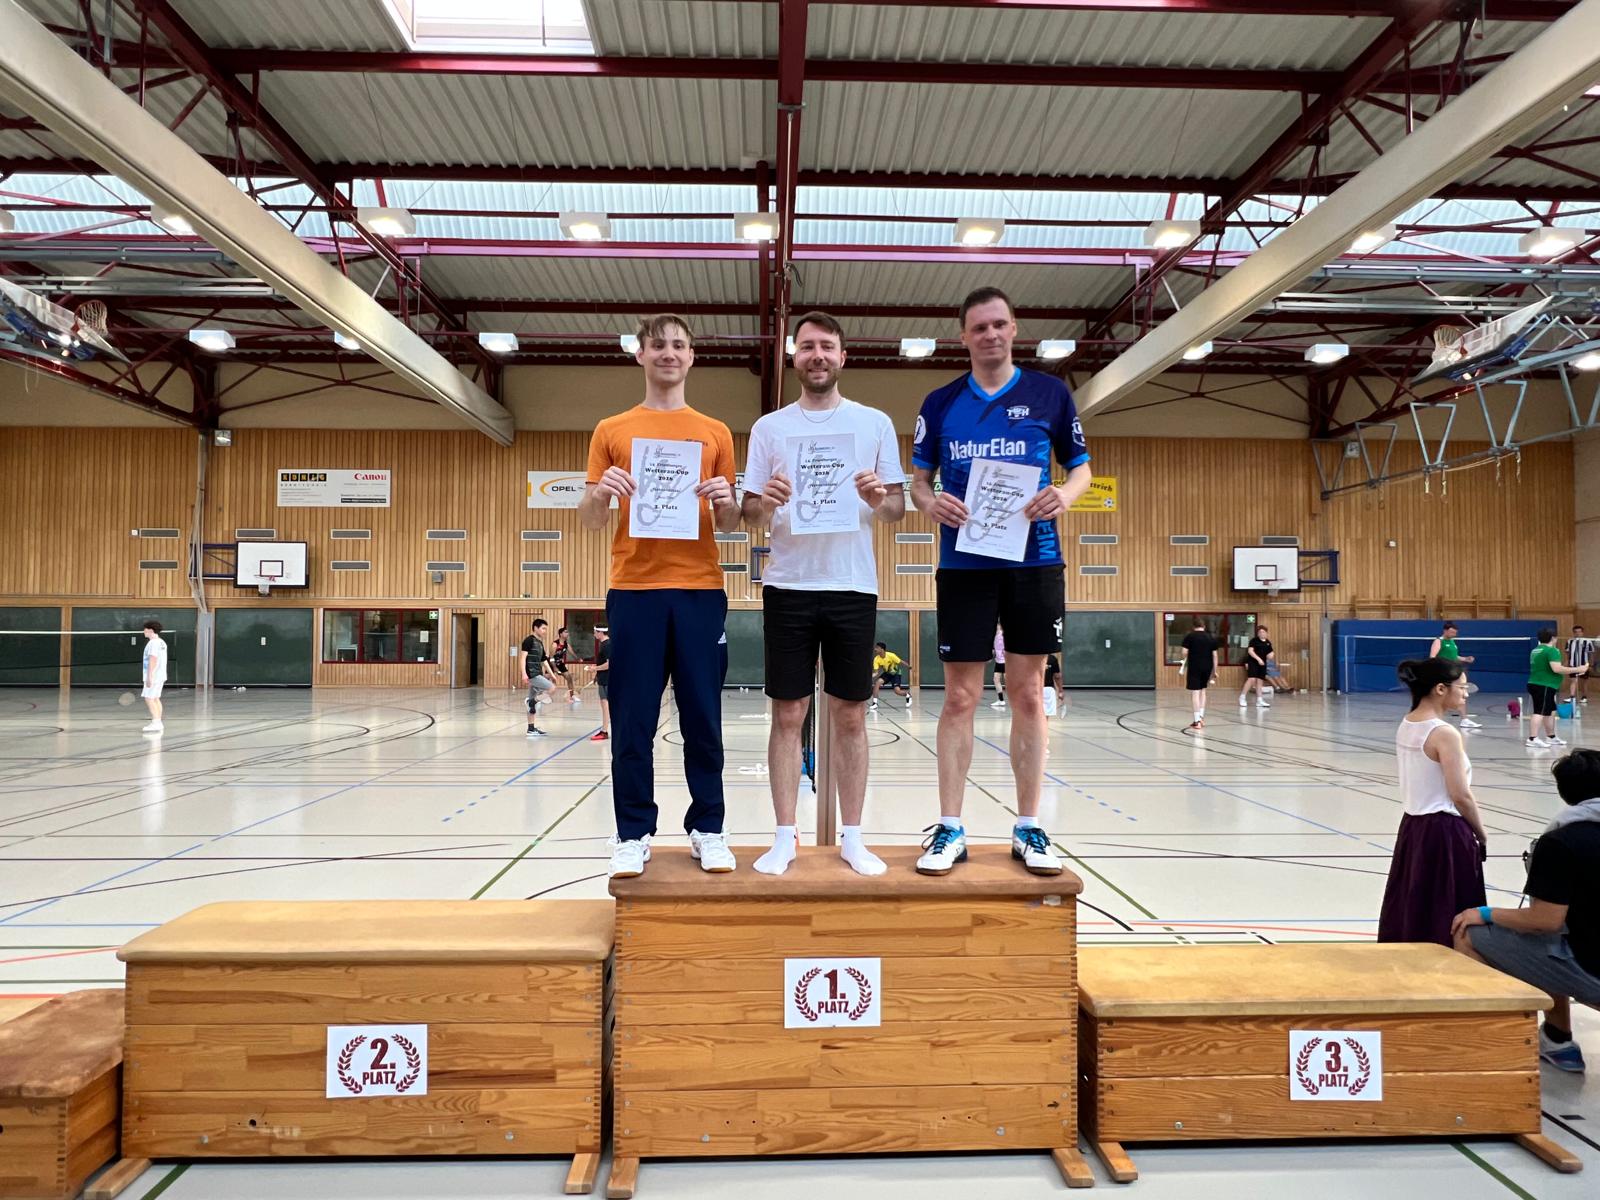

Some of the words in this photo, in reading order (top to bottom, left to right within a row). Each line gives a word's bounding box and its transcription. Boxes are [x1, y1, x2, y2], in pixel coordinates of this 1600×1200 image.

[949, 437, 1026, 460] NaturElan
[354, 473, 387, 481] Canon
[824, 969, 846, 999] 1.
[818, 1001, 849, 1014] PLATZ
[370, 1038, 396, 1069] 2.
[1325, 1041, 1349, 1073] 3.
[362, 1071, 396, 1085] PLATZ
[1318, 1074, 1349, 1087] PLATZ
